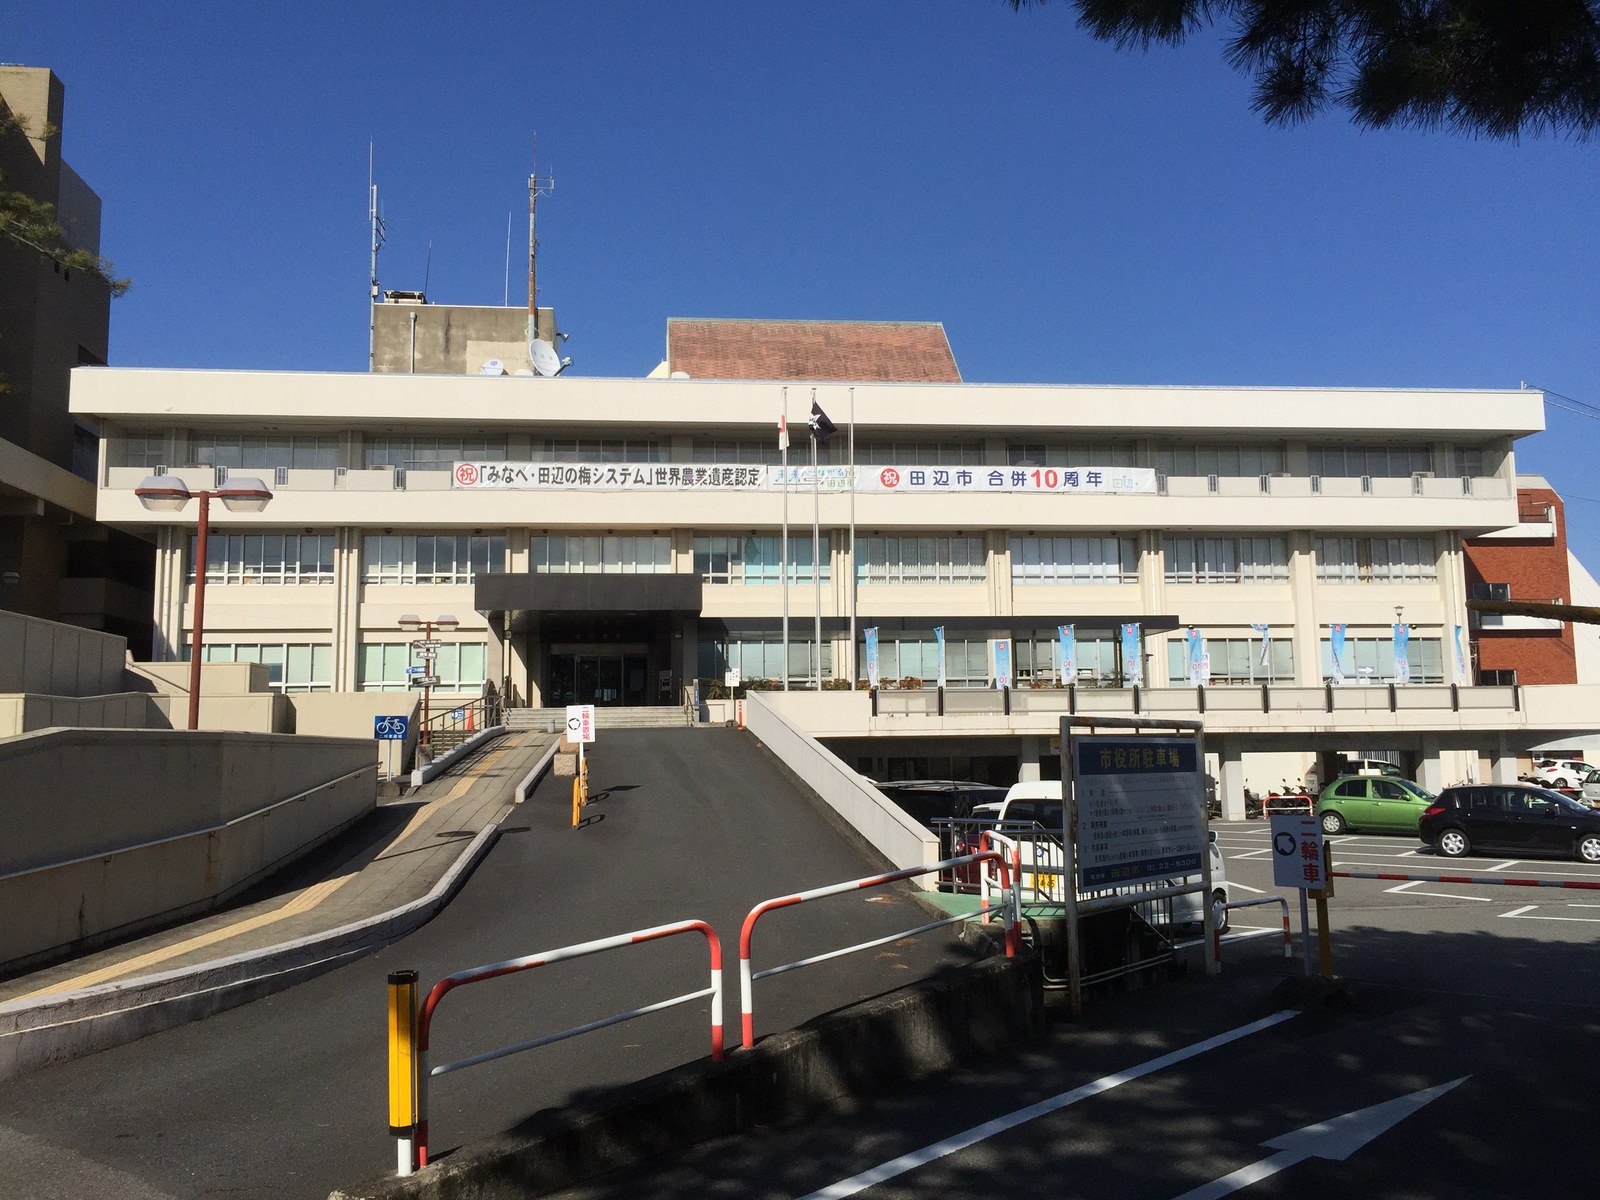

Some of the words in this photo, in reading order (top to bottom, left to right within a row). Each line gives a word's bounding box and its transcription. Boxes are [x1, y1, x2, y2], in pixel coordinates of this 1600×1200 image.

[458, 465, 476, 483] 祝
[882, 469, 898, 486] 祝
[1100, 747, 1180, 770] 市役所駐車場
[1300, 820, 1321, 884] 二輪車
